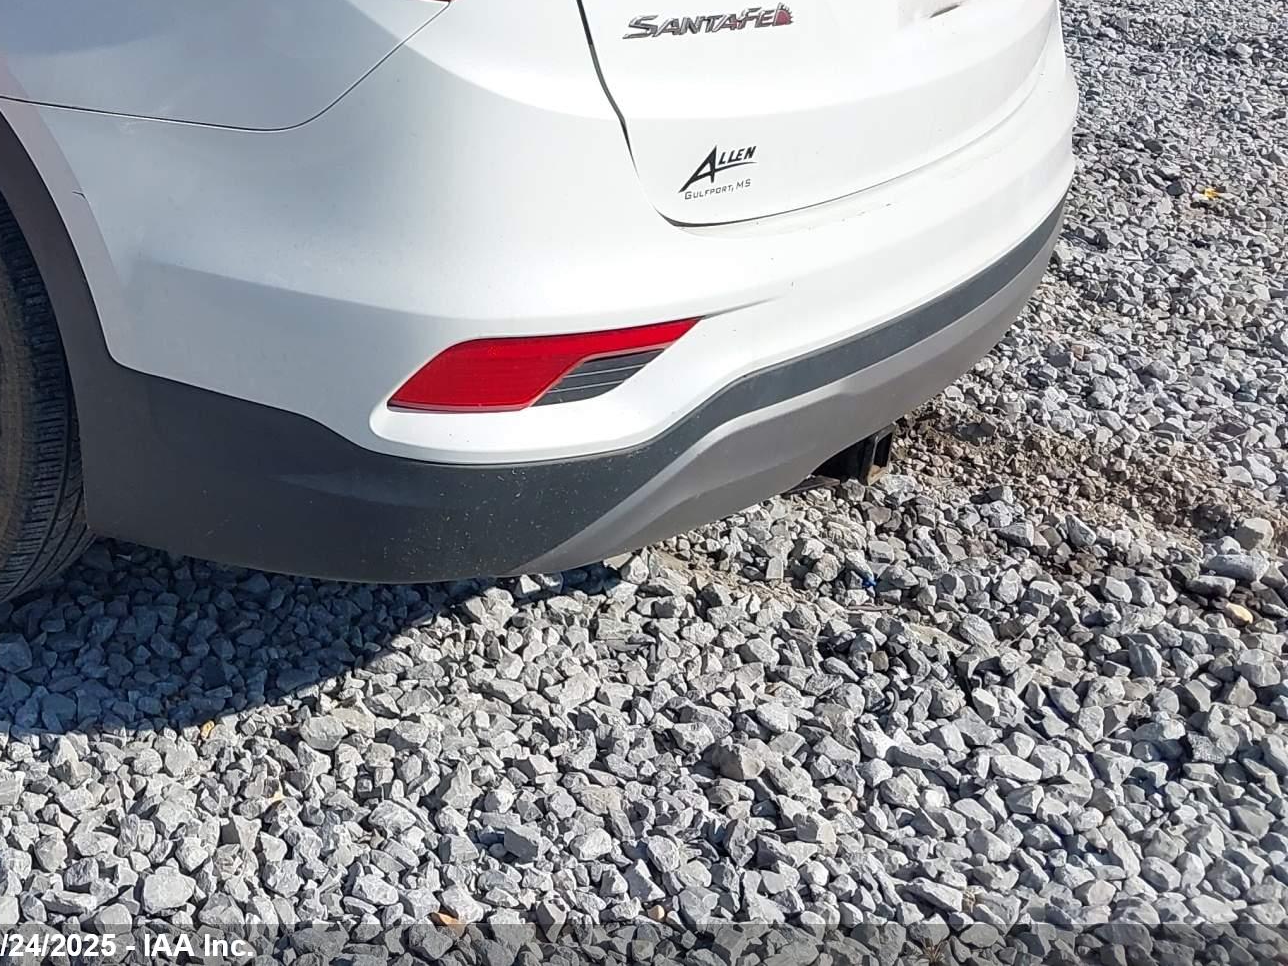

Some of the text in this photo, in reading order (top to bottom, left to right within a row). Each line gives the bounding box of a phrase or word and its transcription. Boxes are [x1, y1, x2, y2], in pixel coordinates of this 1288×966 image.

[678, 145, 757, 193] ALLEN
[684, 178, 751, 200] GULFPORT, MS
